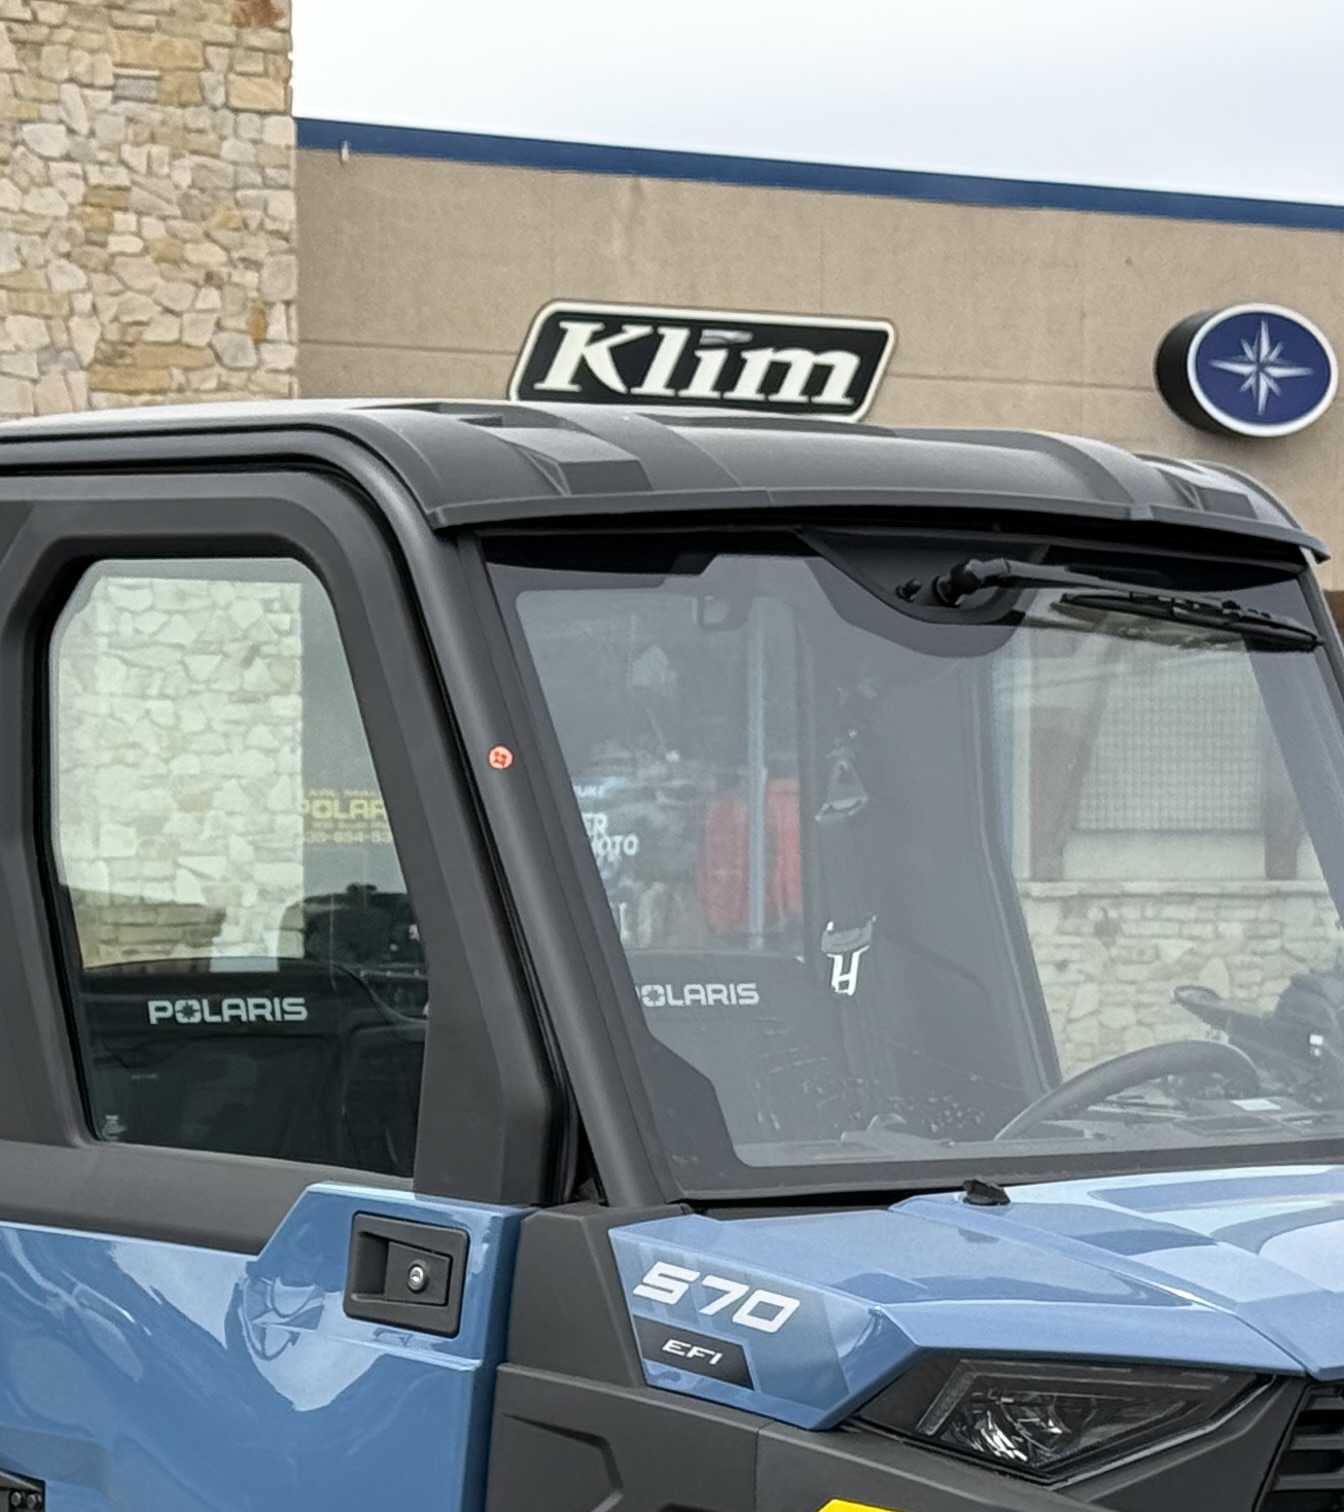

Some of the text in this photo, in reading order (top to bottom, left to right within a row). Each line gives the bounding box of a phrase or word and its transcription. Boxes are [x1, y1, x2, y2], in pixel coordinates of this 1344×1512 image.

[148, 997, 308, 1024] POLARIS
[633, 1262, 801, 1333] 570
[662, 1338, 723, 1366] EFI
